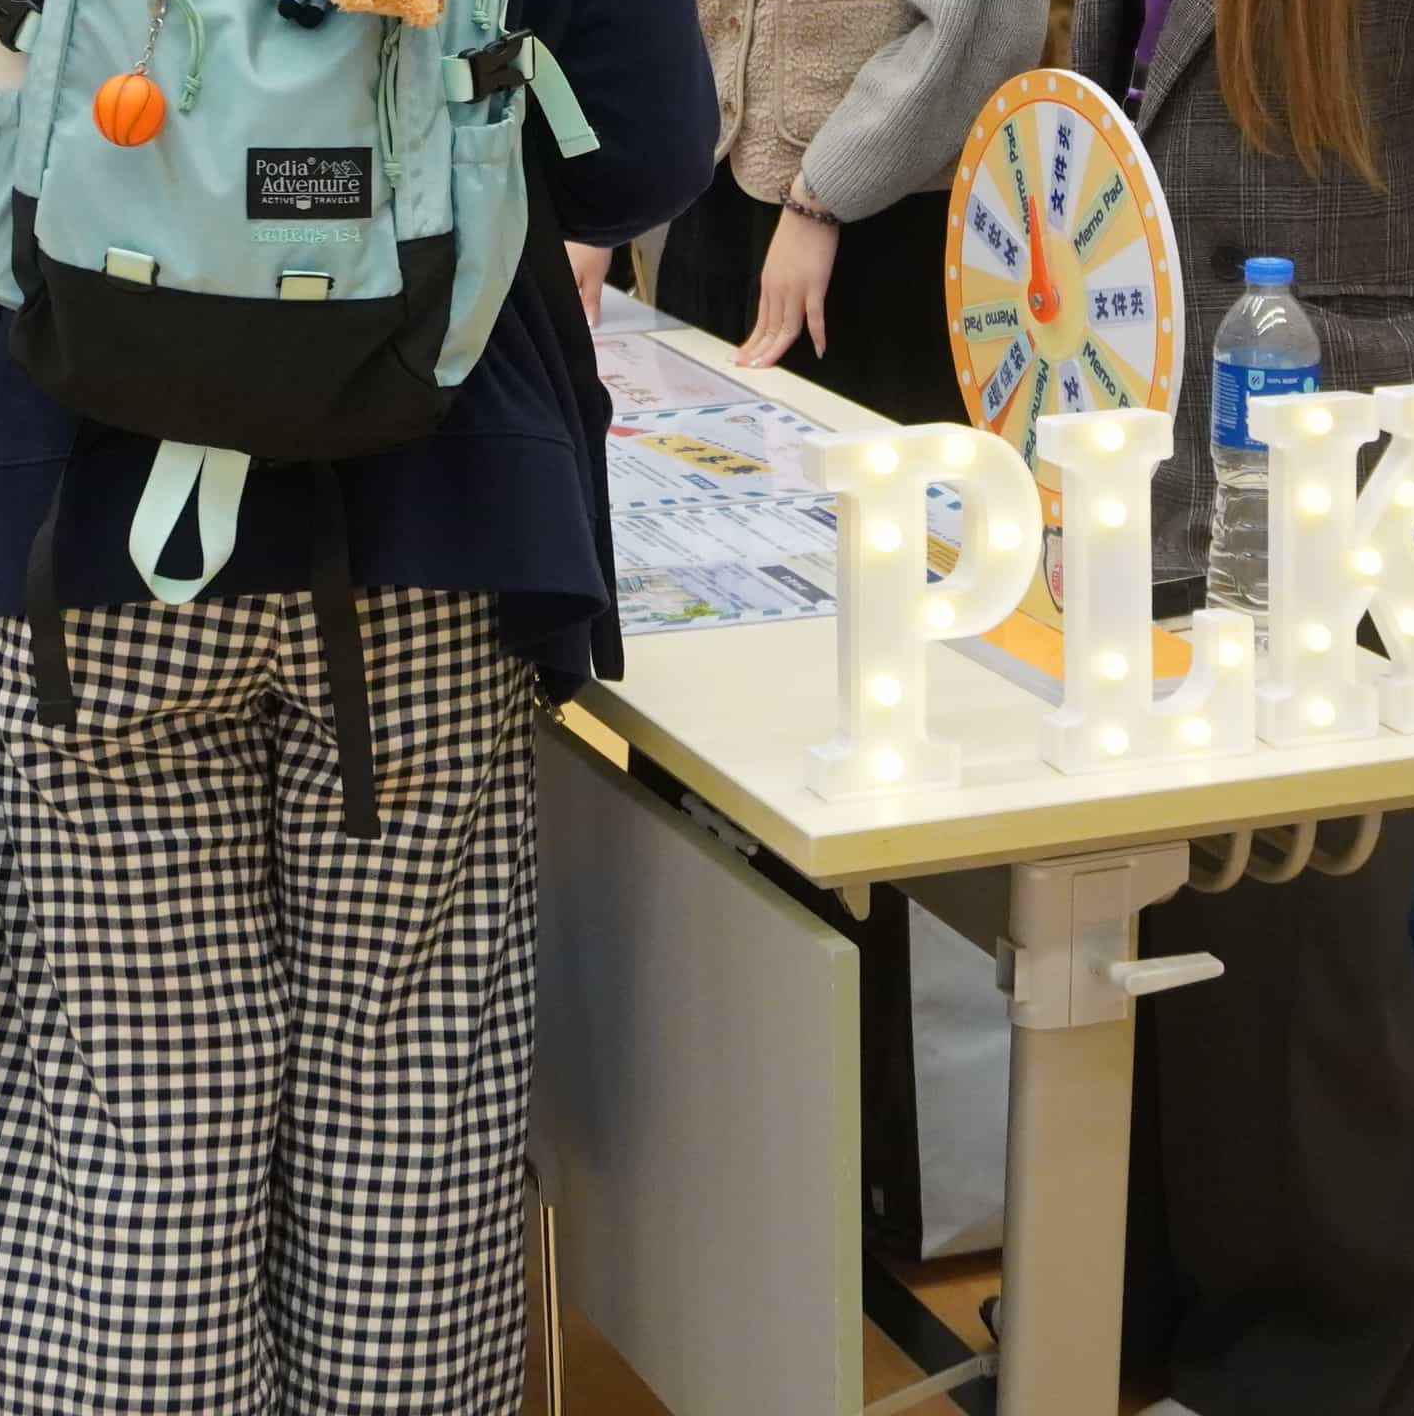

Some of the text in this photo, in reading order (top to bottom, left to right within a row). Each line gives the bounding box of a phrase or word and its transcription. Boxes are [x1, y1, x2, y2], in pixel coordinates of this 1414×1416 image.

[1004, 123, 1018, 163] Pad
[261, 177, 360, 192] Adventure
[1050, 123, 1072, 216] 文件夾
[314, 196, 360, 204] TRAVELER
[1073, 174, 1124, 254] Memo Pad
[973, 203, 1018, 267] 文件夾
[964, 308, 1019, 334] Memo Pad
[1095, 289, 1144, 320] 文件夾
[1031, 358, 1049, 422] Memo
[1082, 341, 1116, 397] Memo
